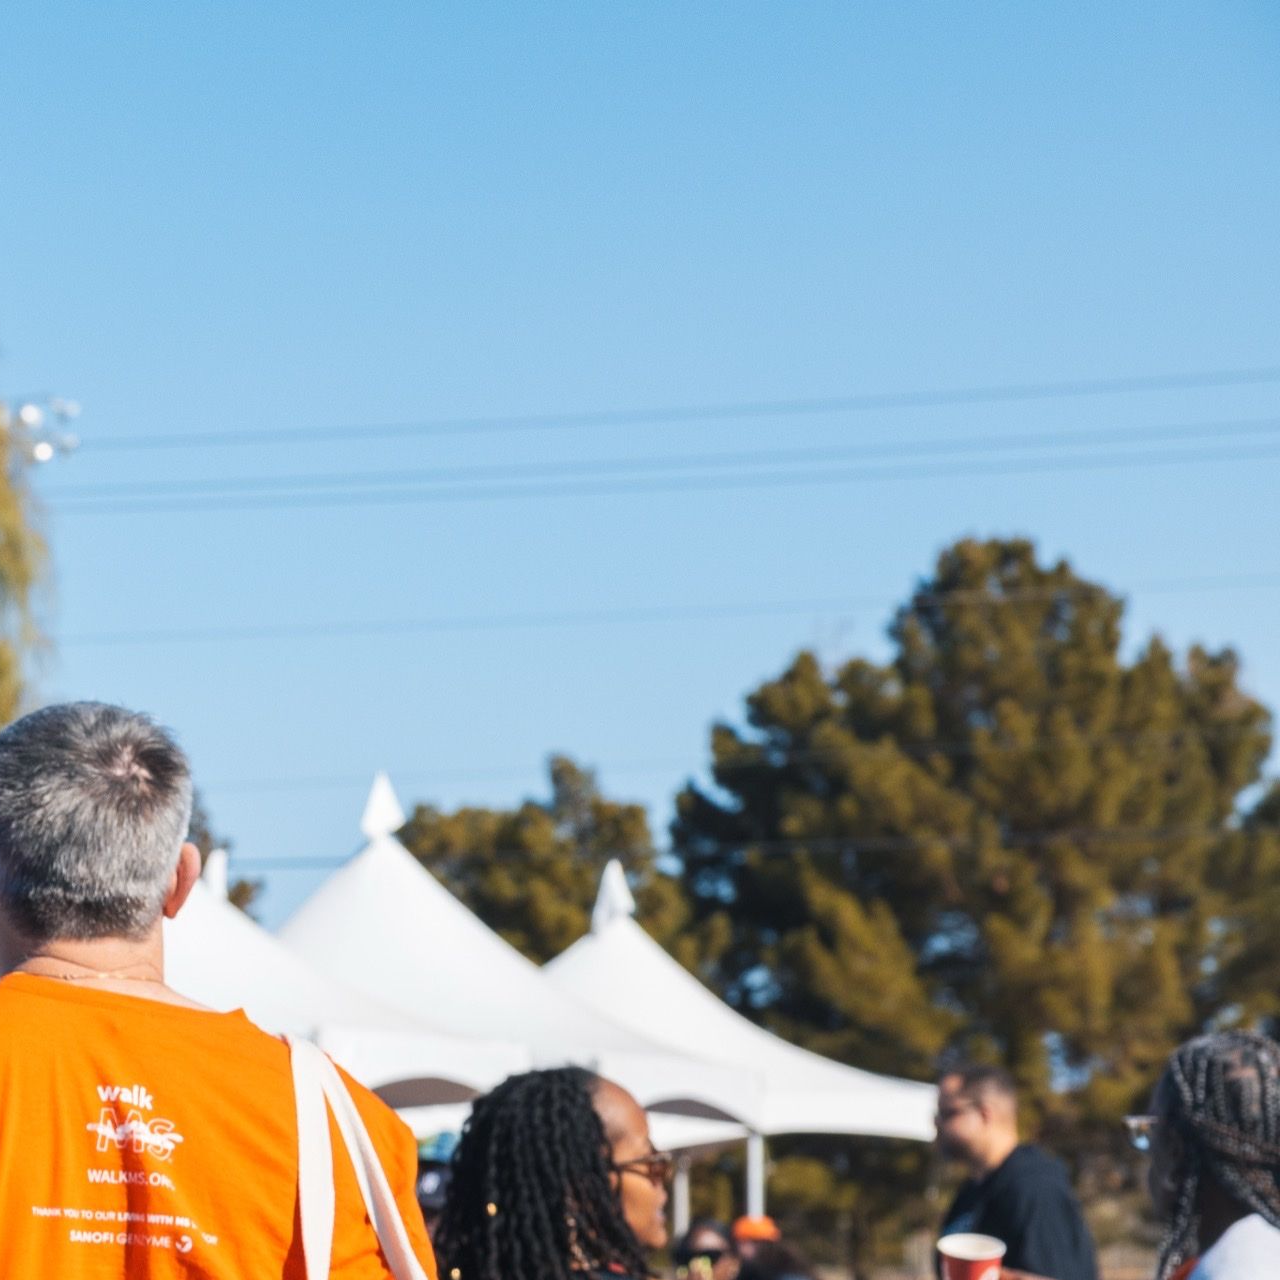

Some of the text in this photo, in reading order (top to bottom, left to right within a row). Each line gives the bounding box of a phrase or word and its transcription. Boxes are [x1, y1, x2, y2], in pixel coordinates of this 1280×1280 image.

[96, 1084, 153, 1111] walk
[95, 1106, 177, 1161] MS
[81, 1210, 94, 1221] TO
[95, 1211, 116, 1221] OUR
[70, 1230, 114, 1244] SANOFI
